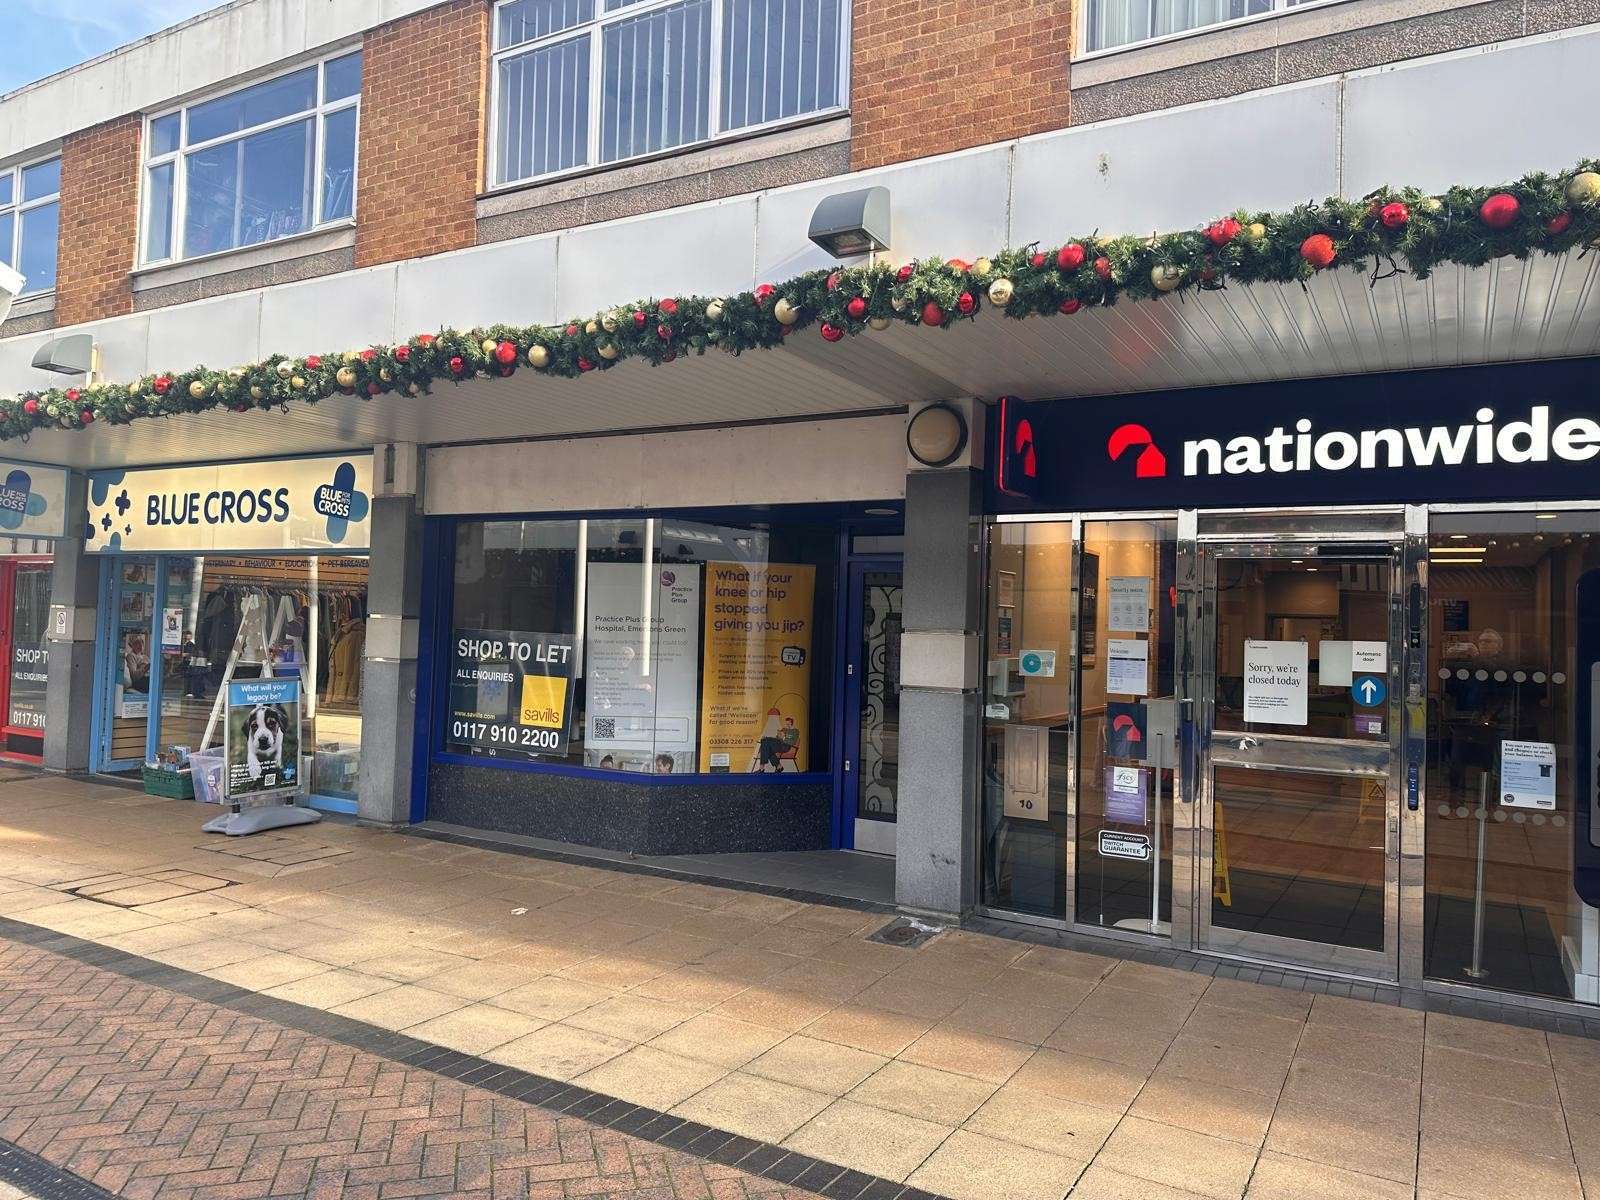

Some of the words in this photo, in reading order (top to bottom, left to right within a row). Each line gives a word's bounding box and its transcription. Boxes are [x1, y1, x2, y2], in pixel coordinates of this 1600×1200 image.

[1183, 405, 1600, 476] nationwide
[320, 487, 342, 502] BLUE
[146, 492, 200, 526] BLUE
[203, 487, 290, 524] CROSS
[318, 500, 350, 517] CROSS
[715, 570, 749, 582] What
[765, 574, 793, 584] your
[715, 585, 746, 598] knee
[750, 588, 764, 598] or
[767, 587, 786, 601] hip
[714, 603, 768, 615] stopped
[714, 618, 752, 632] giving
[757, 621, 779, 632] you
[782, 619, 805, 633] jip?
[16, 648, 41, 663] SHOP
[42, 650, 49, 664] T
[458, 638, 503, 659] SHOP
[507, 641, 531, 662] TO
[535, 643, 571, 664] LET
[456, 669, 471, 679] ALL
[472, 670, 514, 682] ENQUIRIES
[1248, 662, 1275, 674] Sorry,
[1276, 663, 1298, 673] we're
[241, 684, 260, 693] What
[261, 684, 272, 692] will
[1248, 674, 1275, 685] closed
[1277, 676, 1301, 688] today
[246, 693, 269, 702] legacy
[13, 711, 31, 725] 0117
[524, 707, 560, 723] savills
[453, 721, 487, 740] 0117
[490, 724, 518, 743] 910
[521, 728, 560, 749] 2200
[1104, 846, 1141, 854] GUARANTEE
